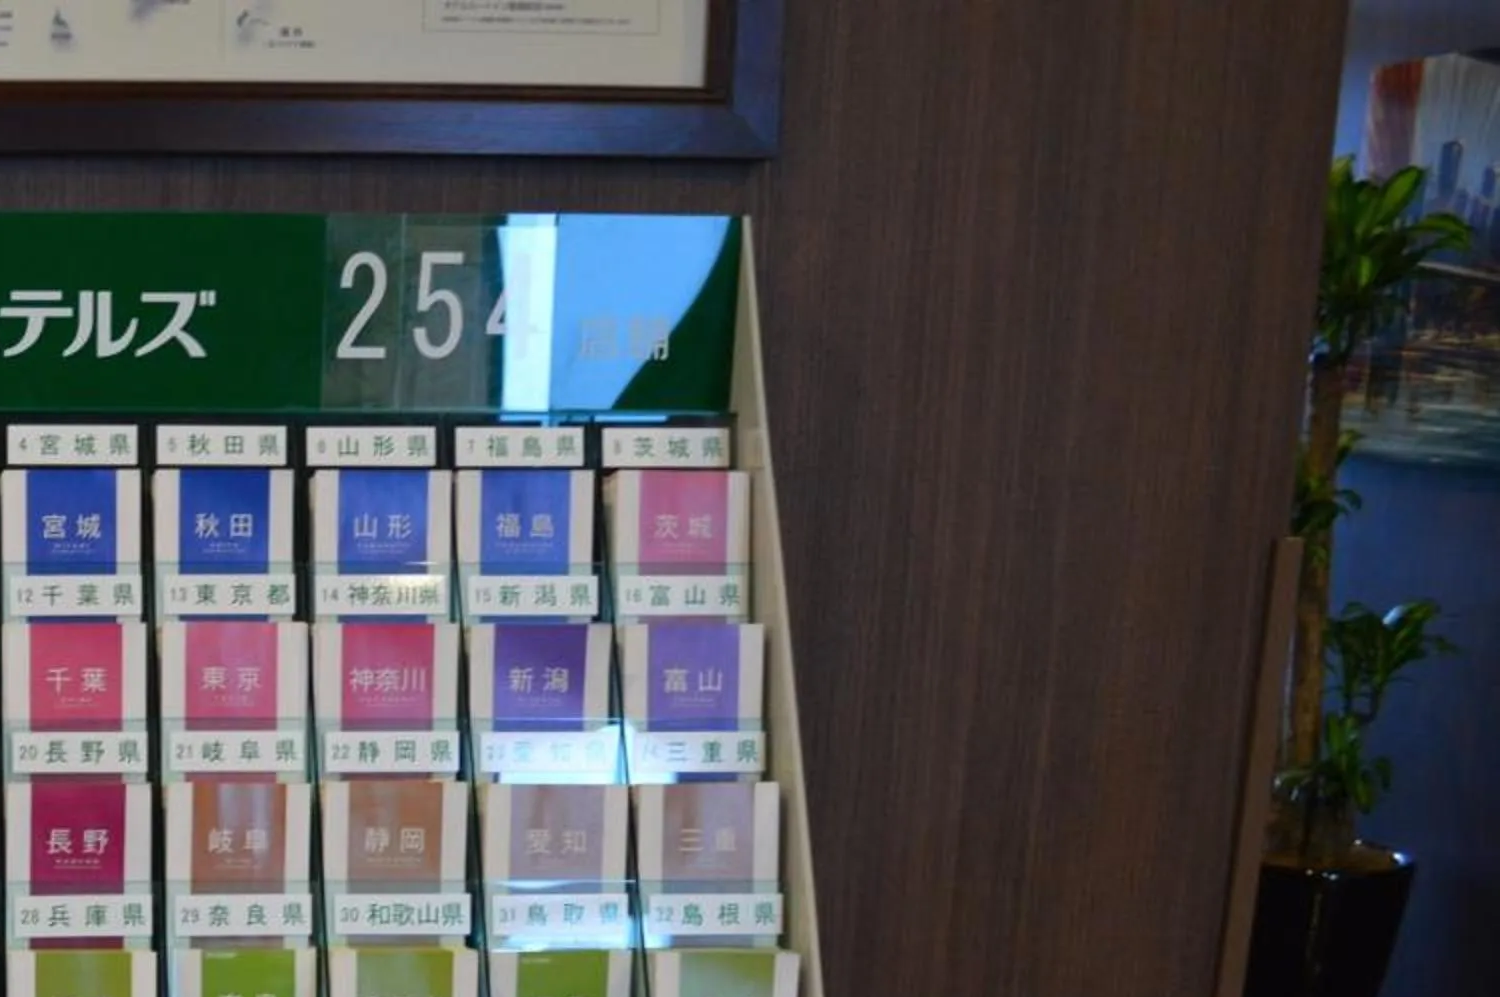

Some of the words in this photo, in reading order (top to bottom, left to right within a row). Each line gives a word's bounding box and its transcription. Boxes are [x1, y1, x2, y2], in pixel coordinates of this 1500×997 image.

[39, 433, 131, 455] 宮城県
[188, 433, 280, 455] 秋田県
[339, 434, 428, 456] 山形県
[487, 434, 577, 456] 福島県
[634, 436, 723, 458] 茨城県
[42, 513, 102, 539] 宮城
[195, 512, 253, 539] 秋田
[353, 513, 412, 539] 山形
[496, 513, 555, 538] 福島
[654, 514, 712, 540] 茨城
[42, 583, 133, 606] 千葉県
[196, 584, 290, 606] 東京都
[348, 584, 439, 606] 神奈川県
[499, 584, 591, 607] 新潟県
[649, 584, 741, 607] 富山県
[45, 666, 107, 694] 千葉
[201, 665, 261, 692] 東京
[349, 666, 426, 693] 神奈川
[509, 667, 570, 693] 新潟
[663, 668, 723, 693] 富山
[20, 744, 38, 762] 20
[44, 740, 140, 764] 長野県
[202, 740, 297, 764] 岐阜県
[358, 740, 453, 763] 静岡県
[669, 740, 759, 763] 三重県
[45, 828, 109, 855] 長野
[208, 828, 270, 854] 岐阜
[364, 827, 425, 852] 静岡
[525, 829, 588, 855] 愛知
[48, 903, 143, 928] 兵庫県
[208, 903, 305, 927] 奈良県
[366, 902, 464, 927] 和歌山県
[526, 901, 625, 927] 鳥取県
[682, 901, 776, 926] 島根県
